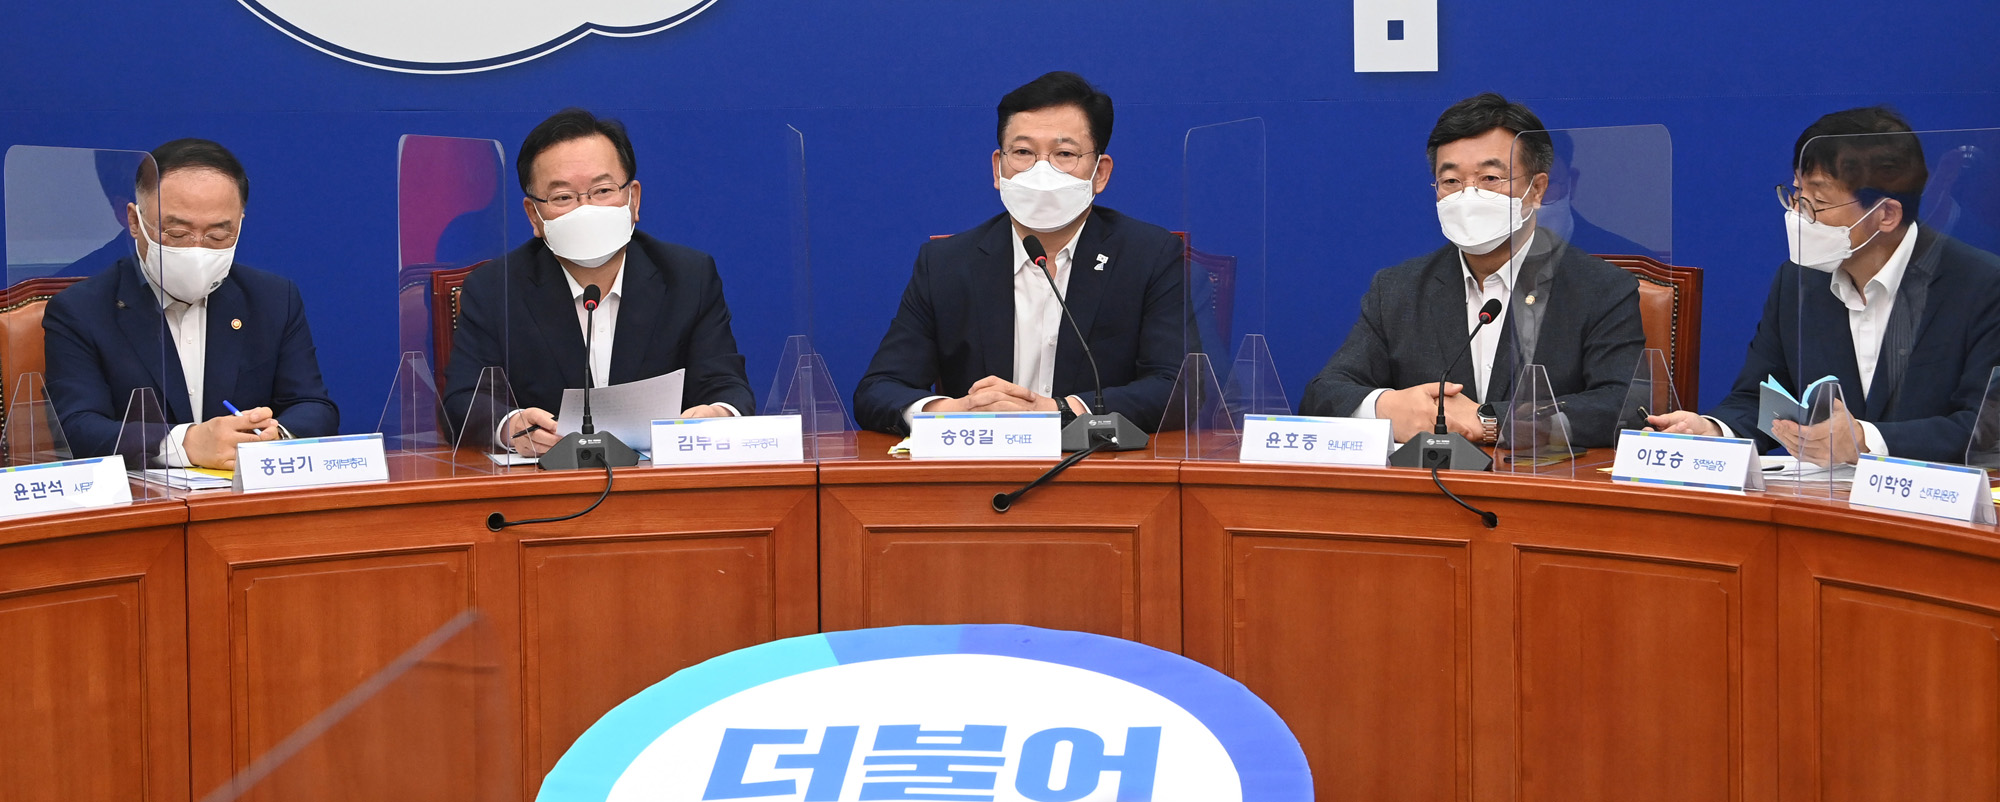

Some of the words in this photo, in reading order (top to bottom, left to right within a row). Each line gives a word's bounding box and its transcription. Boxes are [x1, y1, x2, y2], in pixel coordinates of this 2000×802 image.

[941, 429, 993, 446] 송영길
[1004, 434, 1032, 445] 당대표
[1266, 432, 1317, 451] 윤호중
[1327, 439, 1363, 451] 원내대표
[260, 455, 313, 476] 홍남기
[323, 457, 368, 470] 경제부총리
[1637, 448, 1684, 469] 이호승
[1693, 458, 1726, 472] 정책실장
[14, 480, 64, 501] 윤관석
[1869, 474, 1913, 498] 이학영
[701, 724, 1162, 802] 더불어
